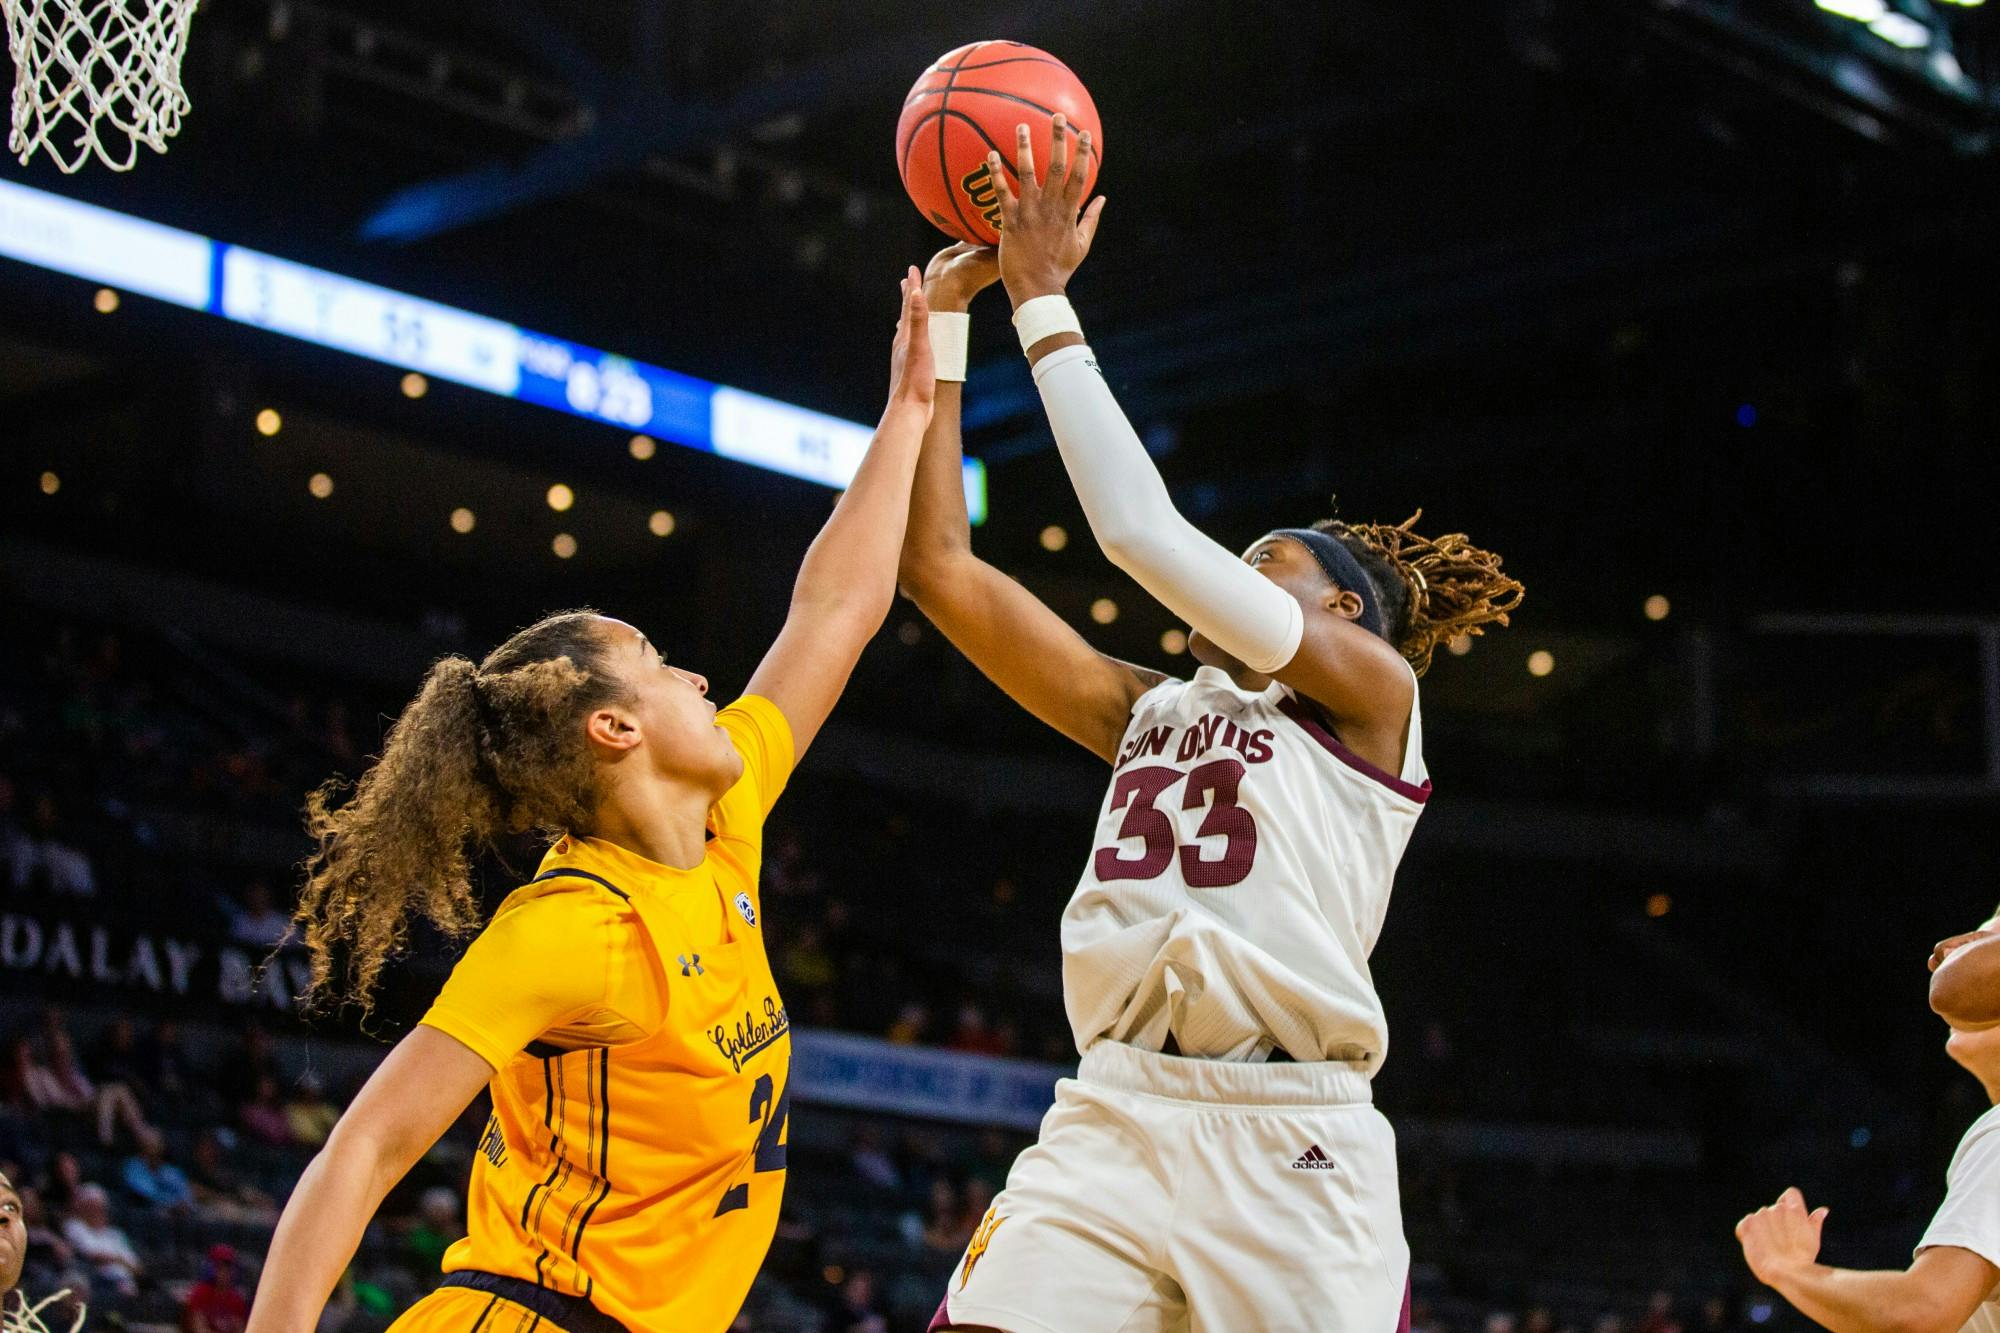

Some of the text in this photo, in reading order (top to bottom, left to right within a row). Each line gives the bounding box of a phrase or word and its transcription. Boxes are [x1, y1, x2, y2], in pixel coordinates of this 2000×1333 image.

[1094, 759, 1257, 887] 33
[707, 1011, 770, 1073] Golden
[1292, 1161, 1335, 1169] adidas
